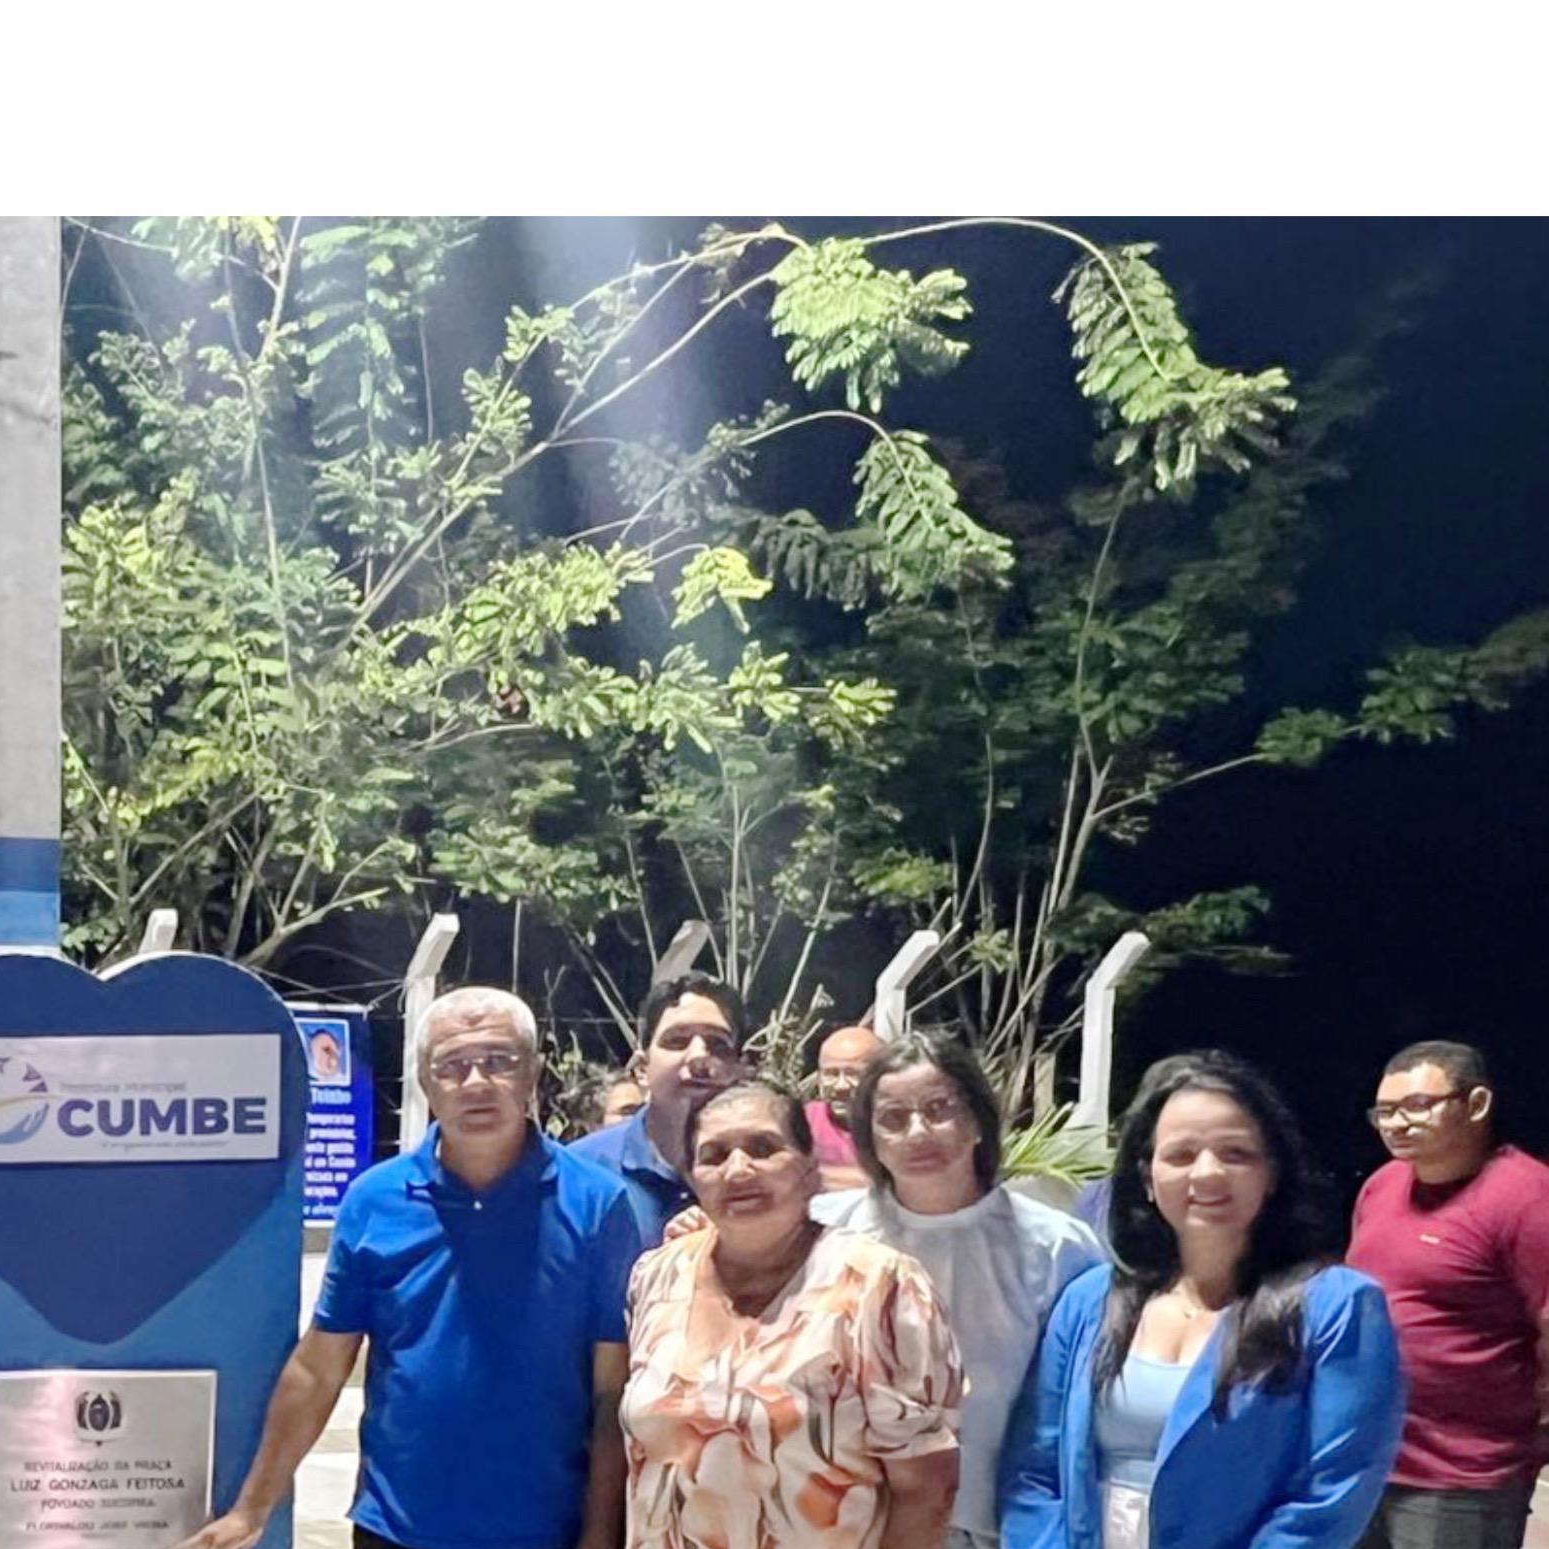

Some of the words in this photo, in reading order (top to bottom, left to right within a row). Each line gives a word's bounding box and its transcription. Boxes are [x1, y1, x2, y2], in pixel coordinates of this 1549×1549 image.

[57, 1097, 266, 1137] CUMBE
[10, 1480, 41, 1492] LUIZ
[49, 1478, 118, 1491] GONZAGA
[126, 1477, 185, 1490] FEITOSA
